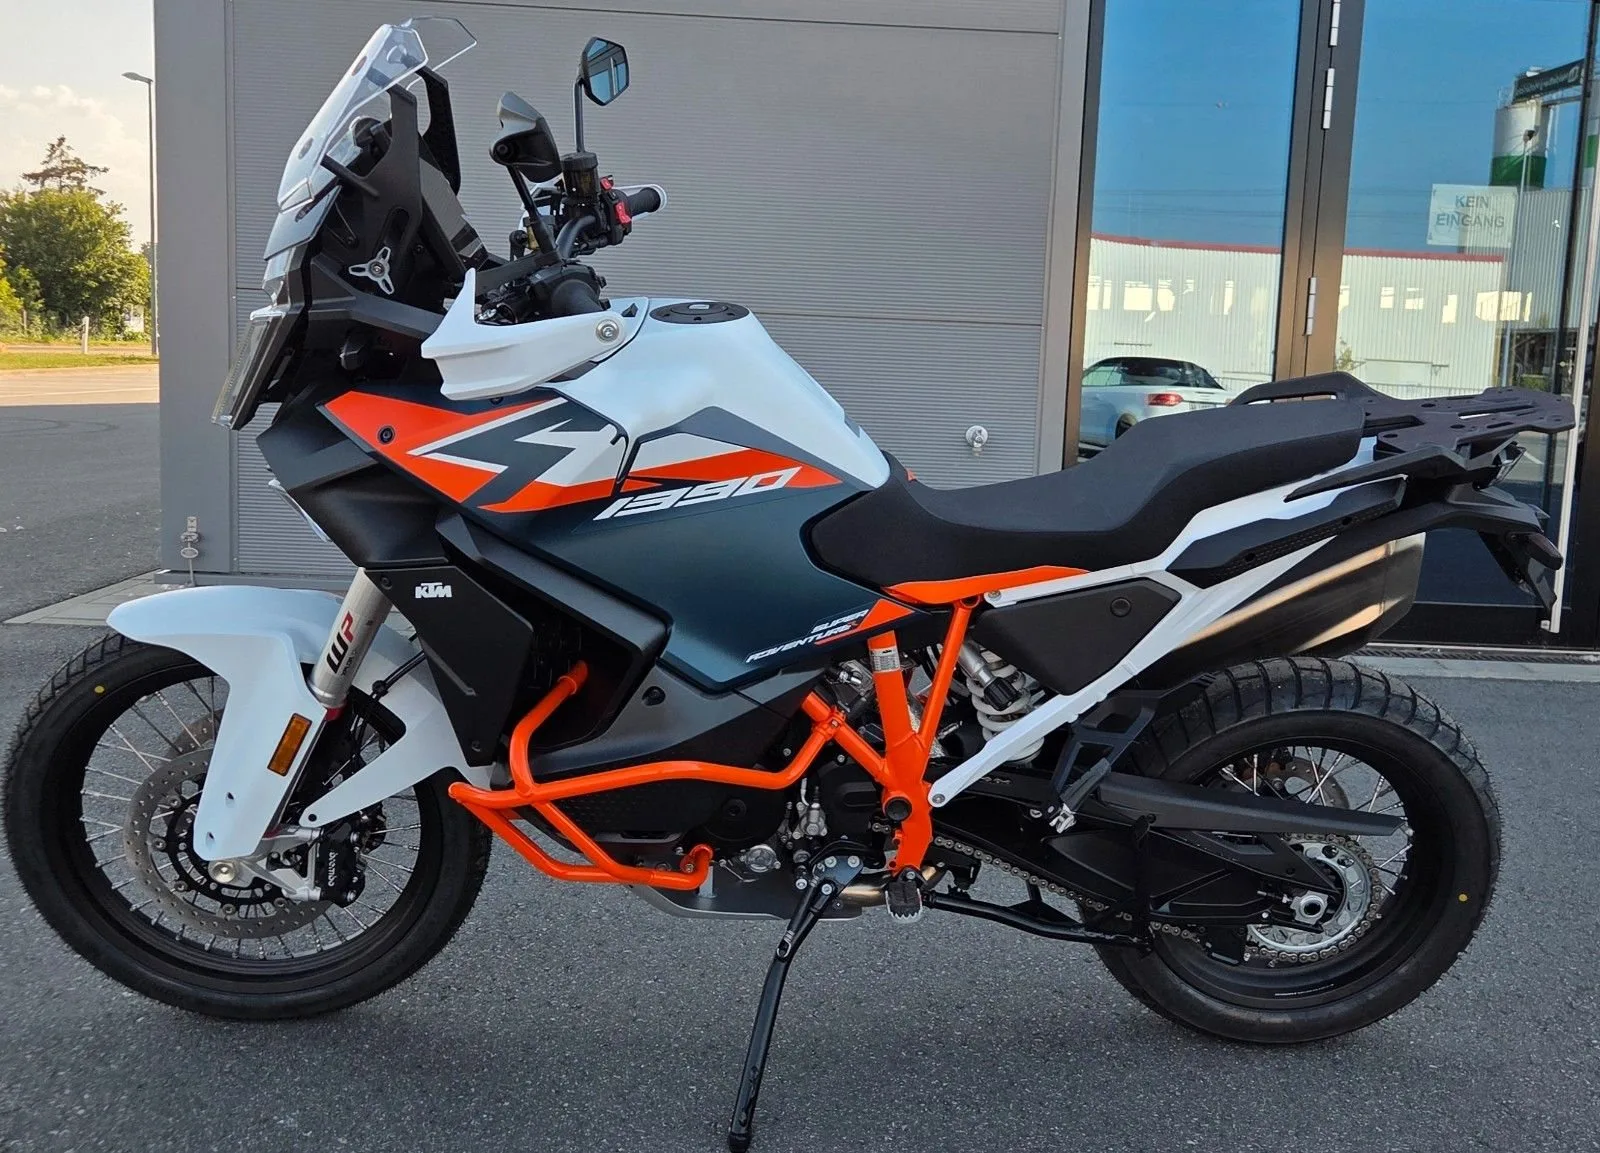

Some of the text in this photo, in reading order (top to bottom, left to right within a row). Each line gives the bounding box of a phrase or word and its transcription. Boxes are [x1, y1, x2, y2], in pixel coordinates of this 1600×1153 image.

[1455, 194, 1489, 209] KEIN
[1436, 212, 1505, 228] EINGANG
[593, 466, 803, 521] 1390
[415, 582, 453, 599] KTM
[811, 608, 870, 634] SUPER
[326, 610, 354, 675] WP
[745, 623, 852, 664] ADVENTURE
[327, 851, 338, 887] brembo
